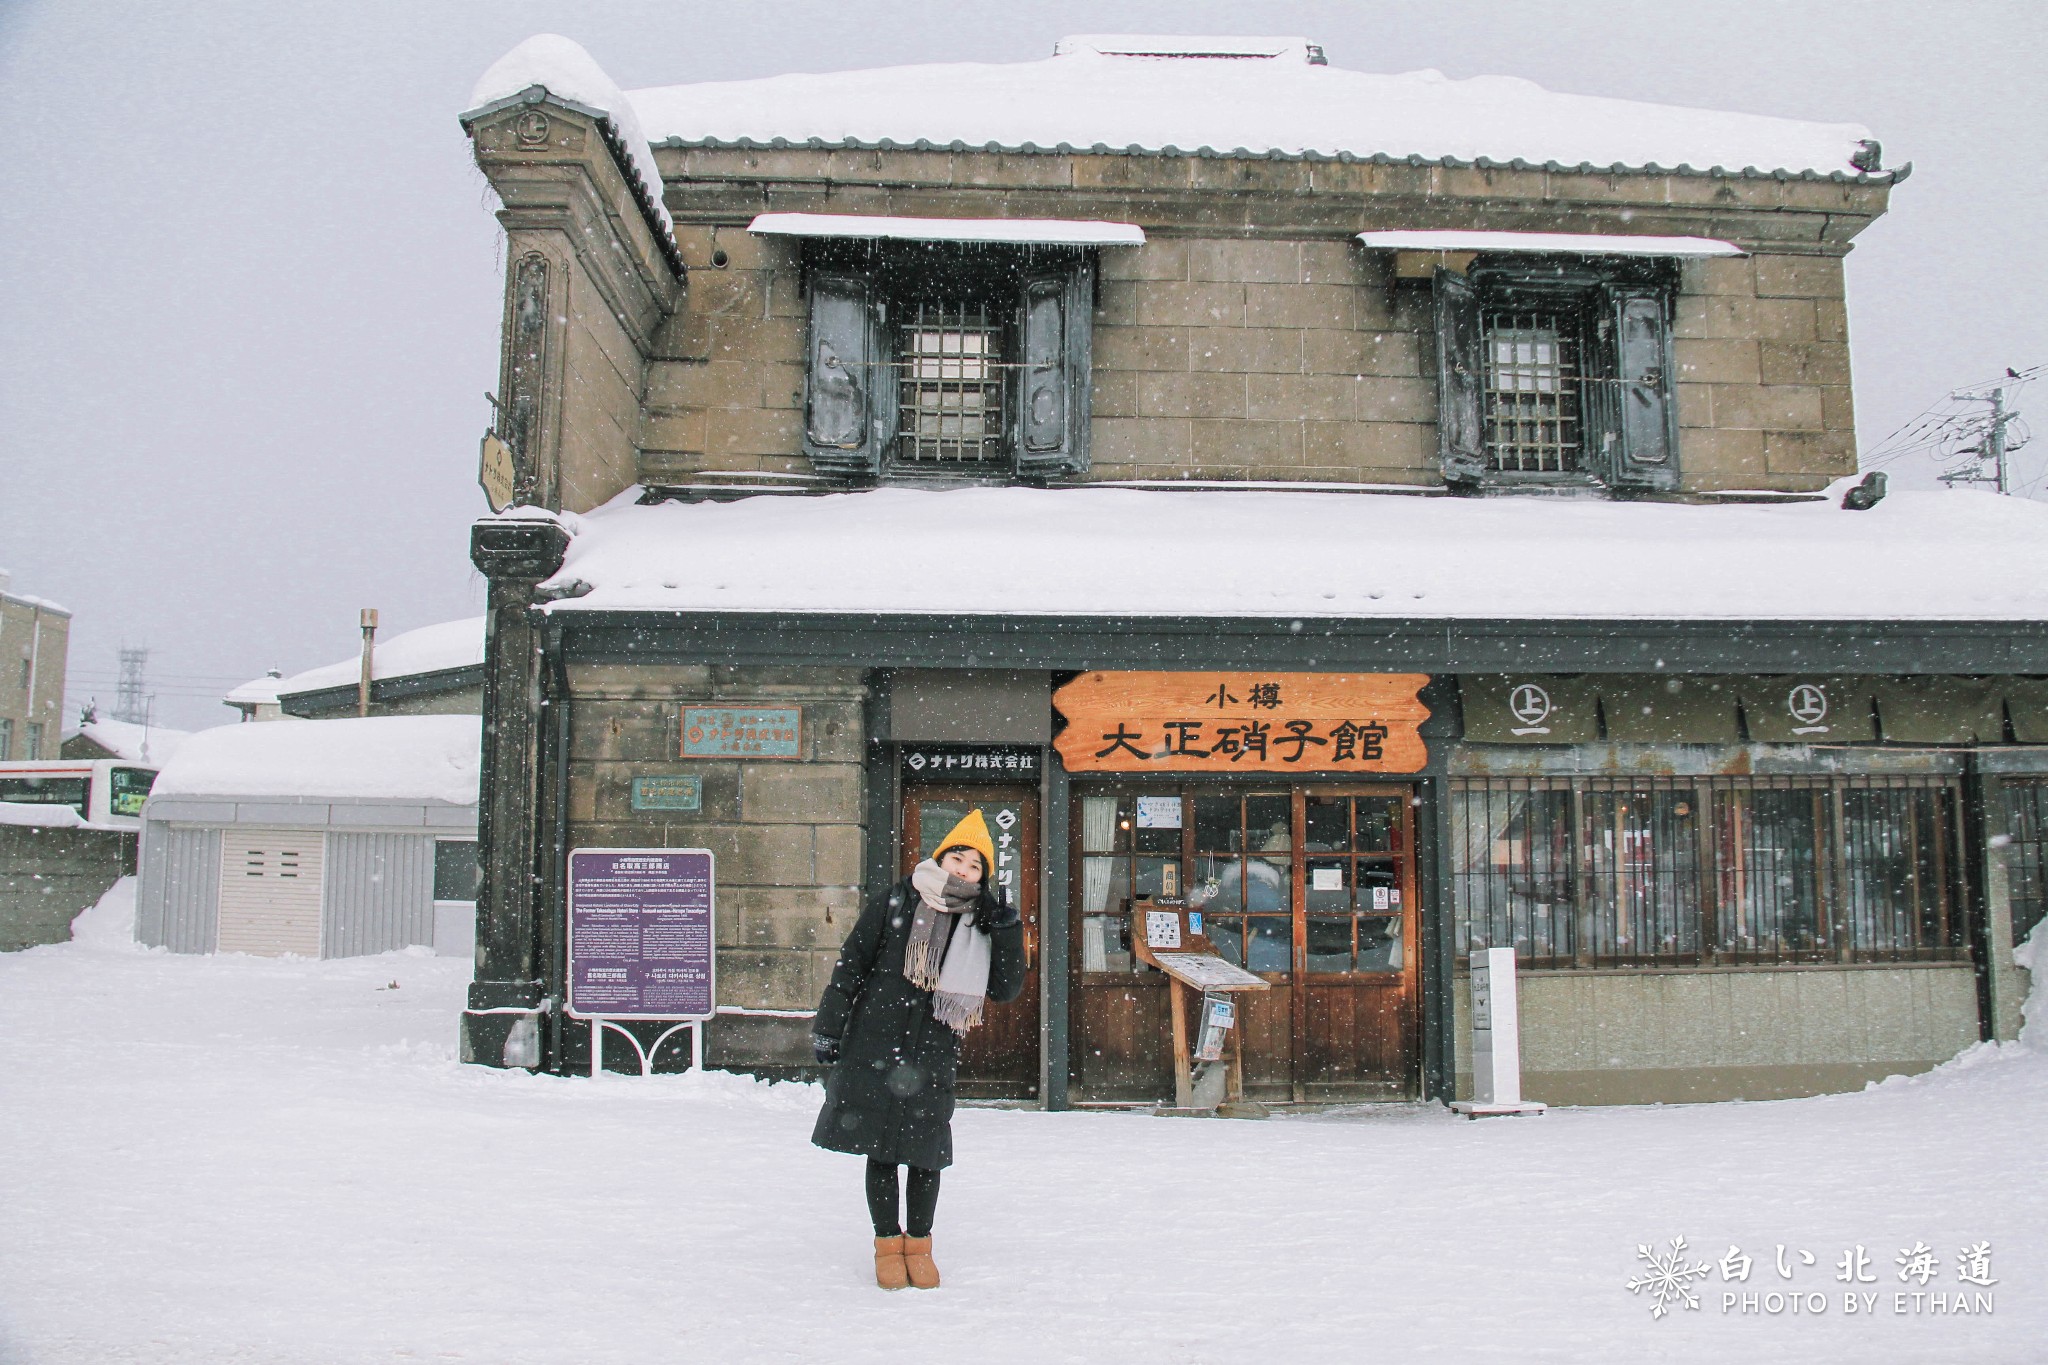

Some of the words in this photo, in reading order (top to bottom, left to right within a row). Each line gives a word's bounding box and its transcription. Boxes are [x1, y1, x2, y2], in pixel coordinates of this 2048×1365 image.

[1206, 683, 1283, 709] 小樽
[1095, 720, 1388, 762] 大正硝子館
[930, 755, 1034, 769] ナトリ株式会社
